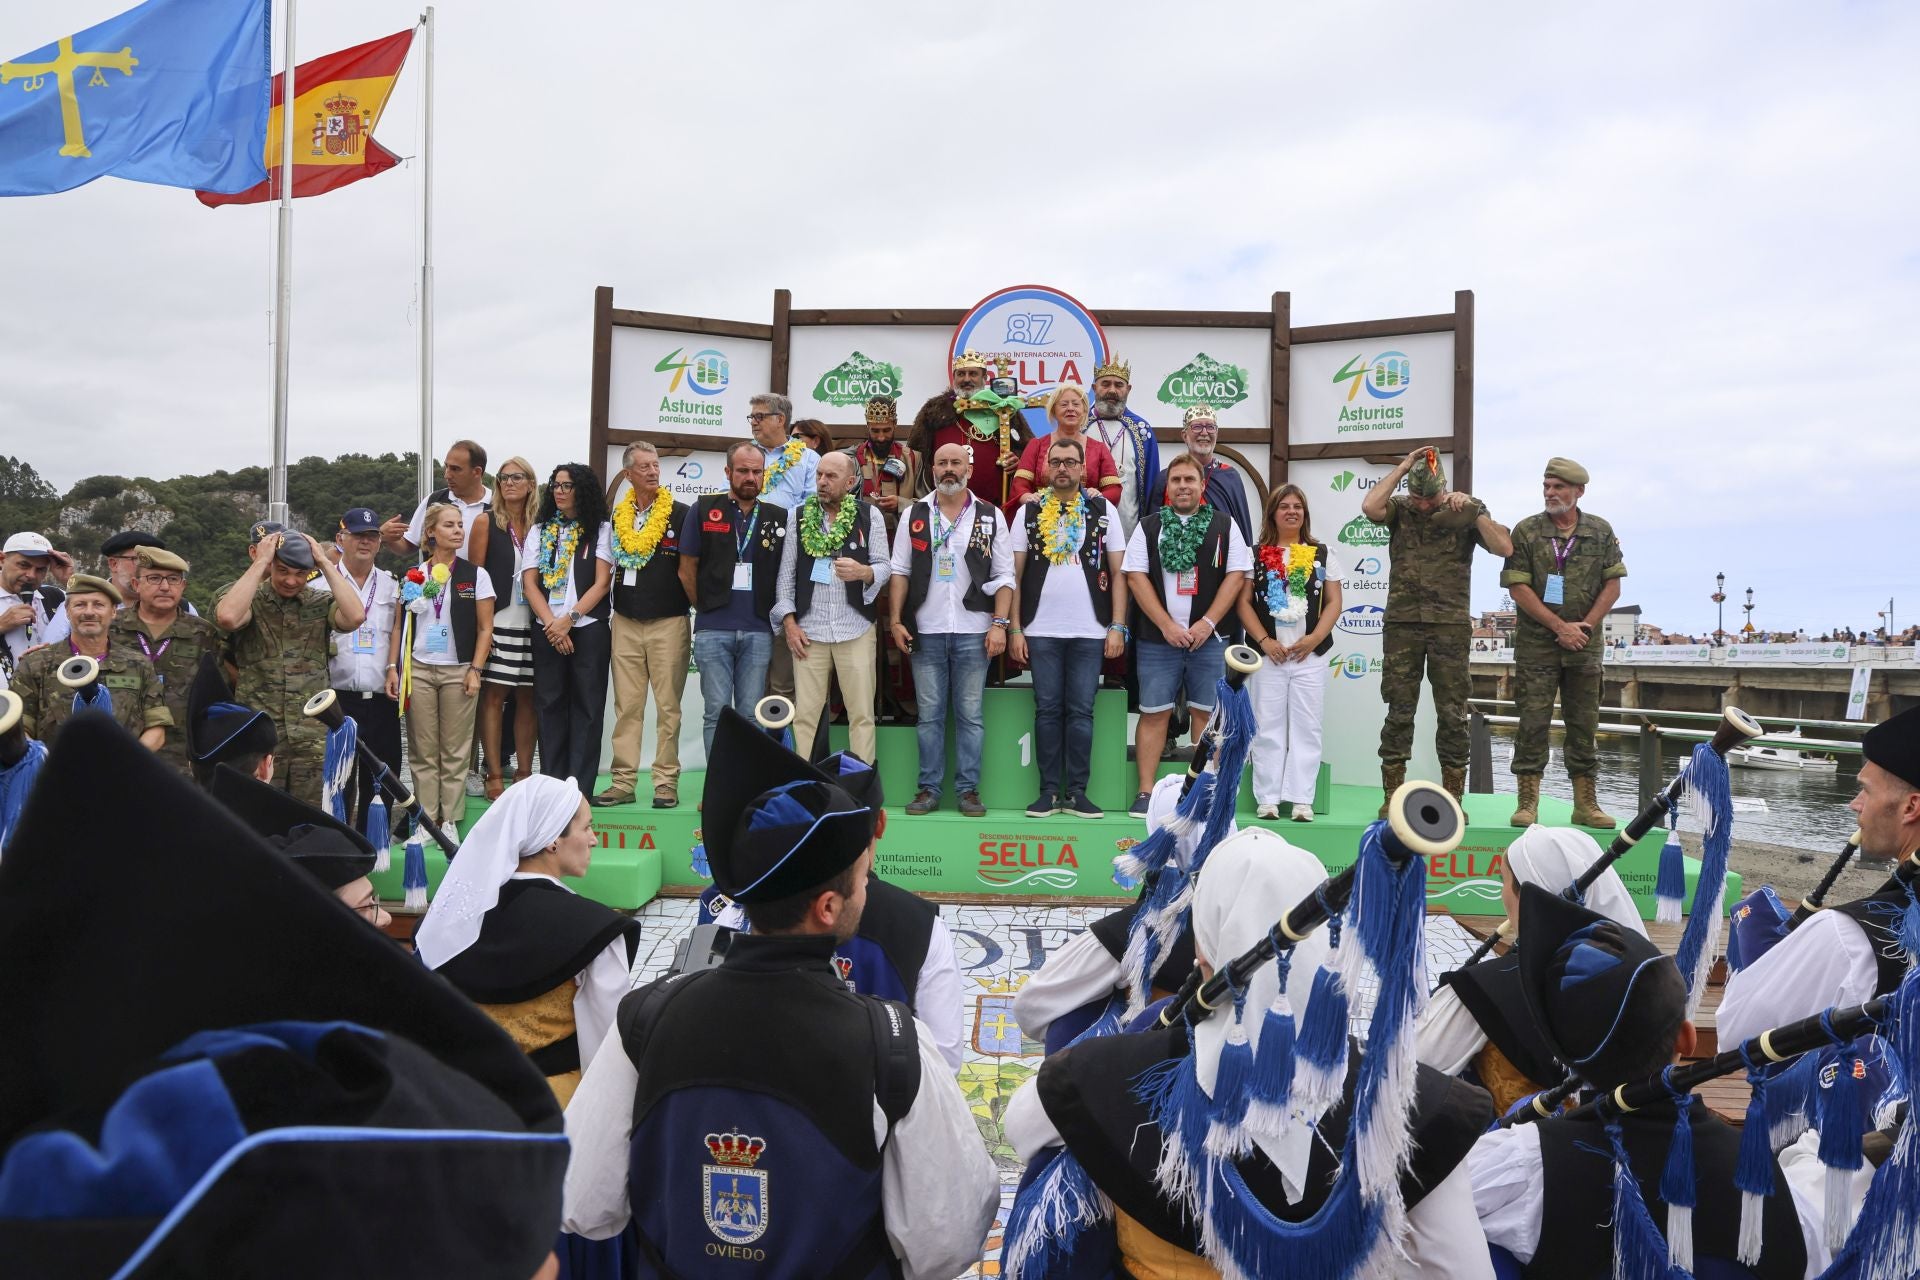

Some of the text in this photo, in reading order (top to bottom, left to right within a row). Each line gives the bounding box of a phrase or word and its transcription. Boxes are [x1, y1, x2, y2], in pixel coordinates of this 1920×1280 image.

[1006, 313, 1054, 345] 87
[659, 396, 723, 416] Asturias
[1338, 405, 1404, 422] Asturias
[658, 414, 723, 427] paraíso natural
[1338, 420, 1404, 434] paraíso natural
[675, 483, 719, 494] eléctric
[1357, 477, 1409, 492] Unja
[1353, 580, 1389, 590] eléctr
[1340, 615, 1383, 628] ASTURIA
[441, 628, 447, 637] 6
[1018, 732, 1031, 767] 1
[1014, 834, 1064, 842] INTERNACIONAL
[875, 853, 942, 864] yuntamiento
[979, 841, 1079, 869] SELLA
[881, 864, 942, 876] Ribadesella
[1424, 853, 1502, 878] ELLA
[1620, 871, 1657, 882] miento
[705, 1242, 766, 1262] OVIEDO
